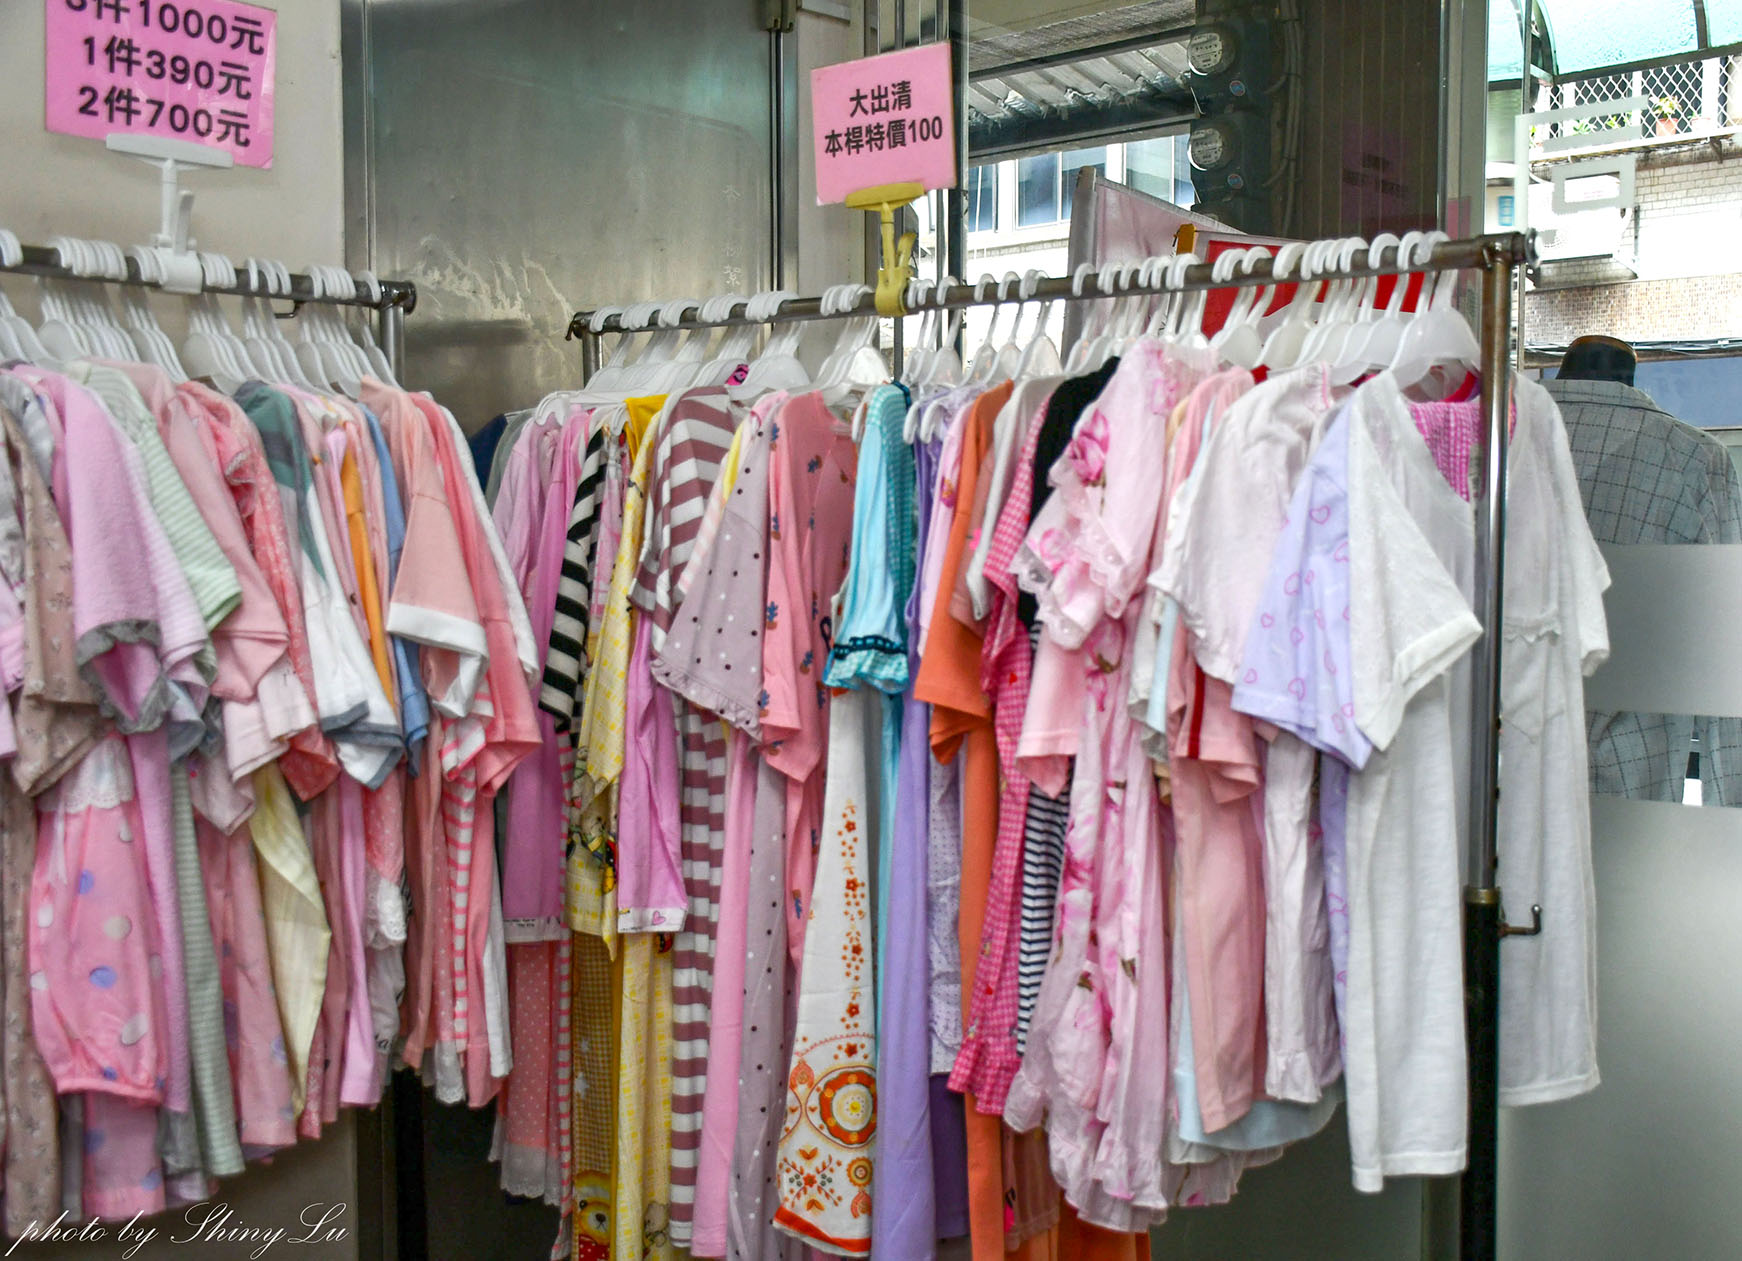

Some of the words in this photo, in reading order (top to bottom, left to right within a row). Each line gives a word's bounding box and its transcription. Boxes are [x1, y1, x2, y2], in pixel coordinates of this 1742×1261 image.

[84, 35, 251, 100] 1件390元
[79, 86, 250, 147] 2件700元
[849, 80, 911, 117] 大出清
[825, 116, 943, 157] 本桿特價100
